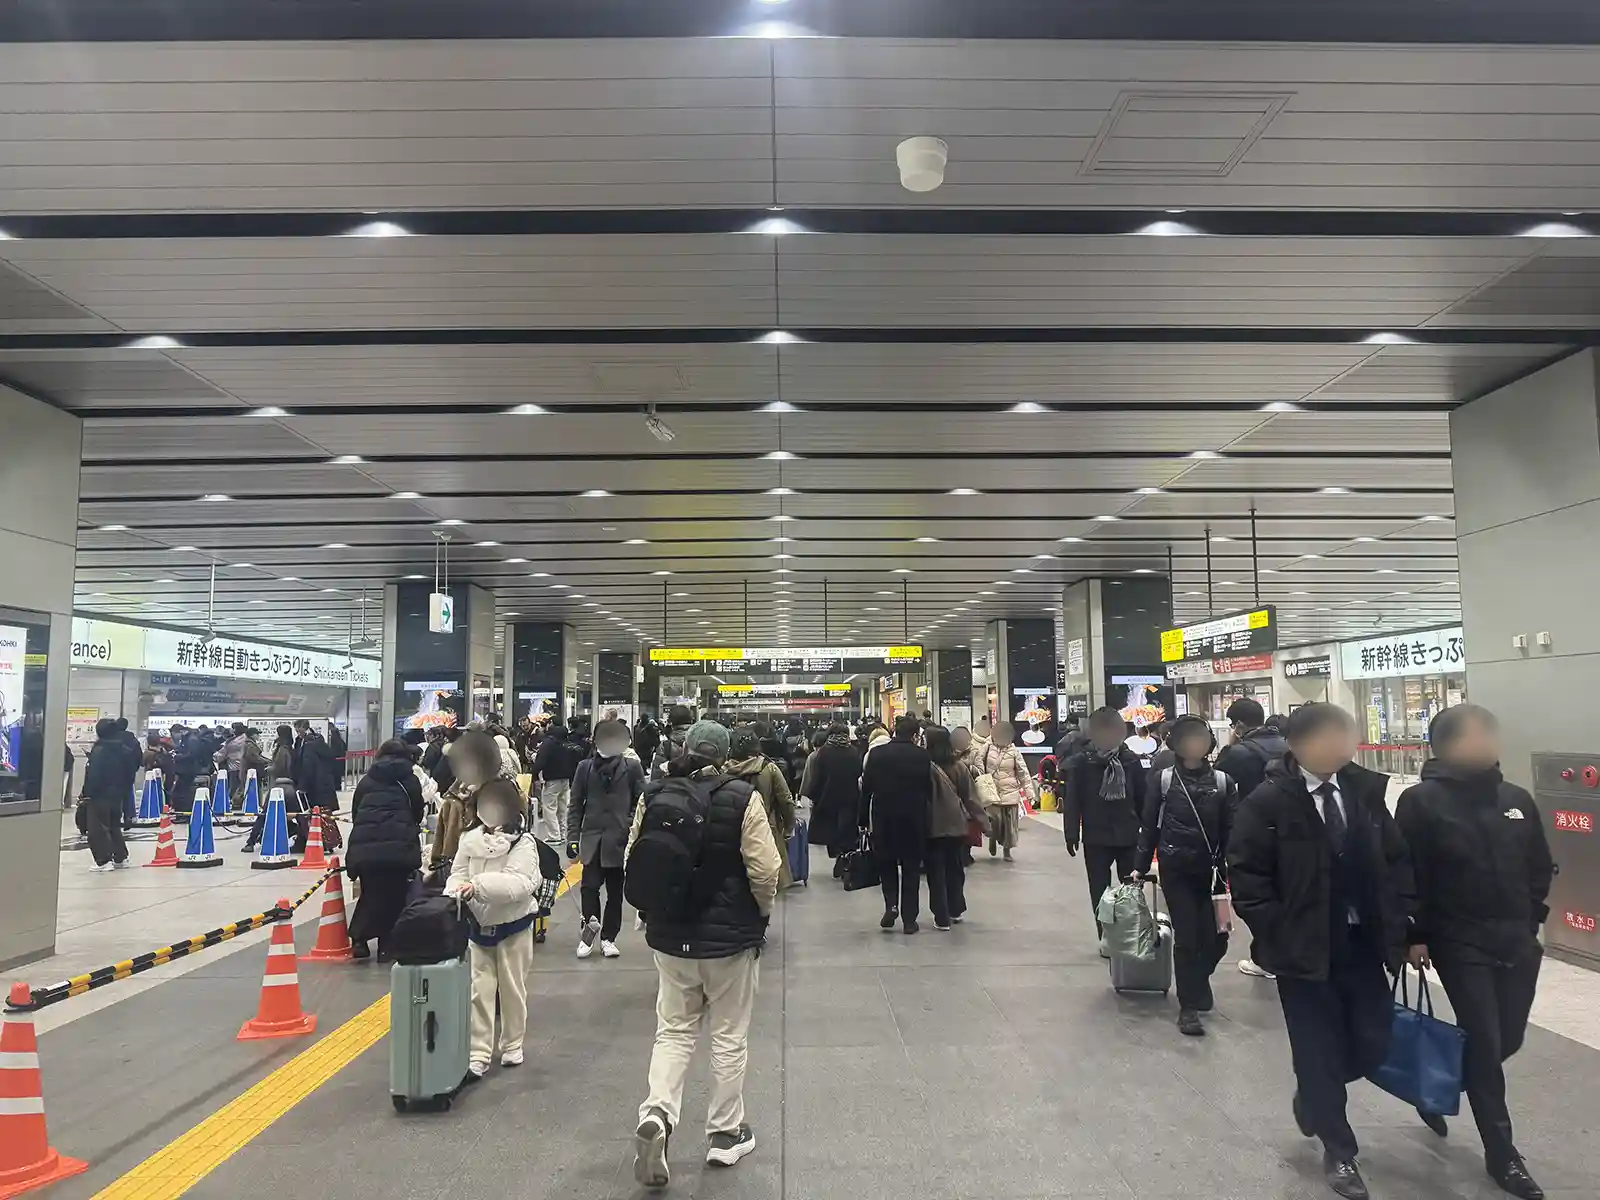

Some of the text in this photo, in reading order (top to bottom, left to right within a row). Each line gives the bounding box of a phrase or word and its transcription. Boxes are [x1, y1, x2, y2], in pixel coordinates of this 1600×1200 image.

[176, 640, 313, 676] 新幹線自動きっぷうりば
[1361, 637, 1465, 672] 新幹線きっぷ
[1557, 812, 1590, 829] 消火栓
